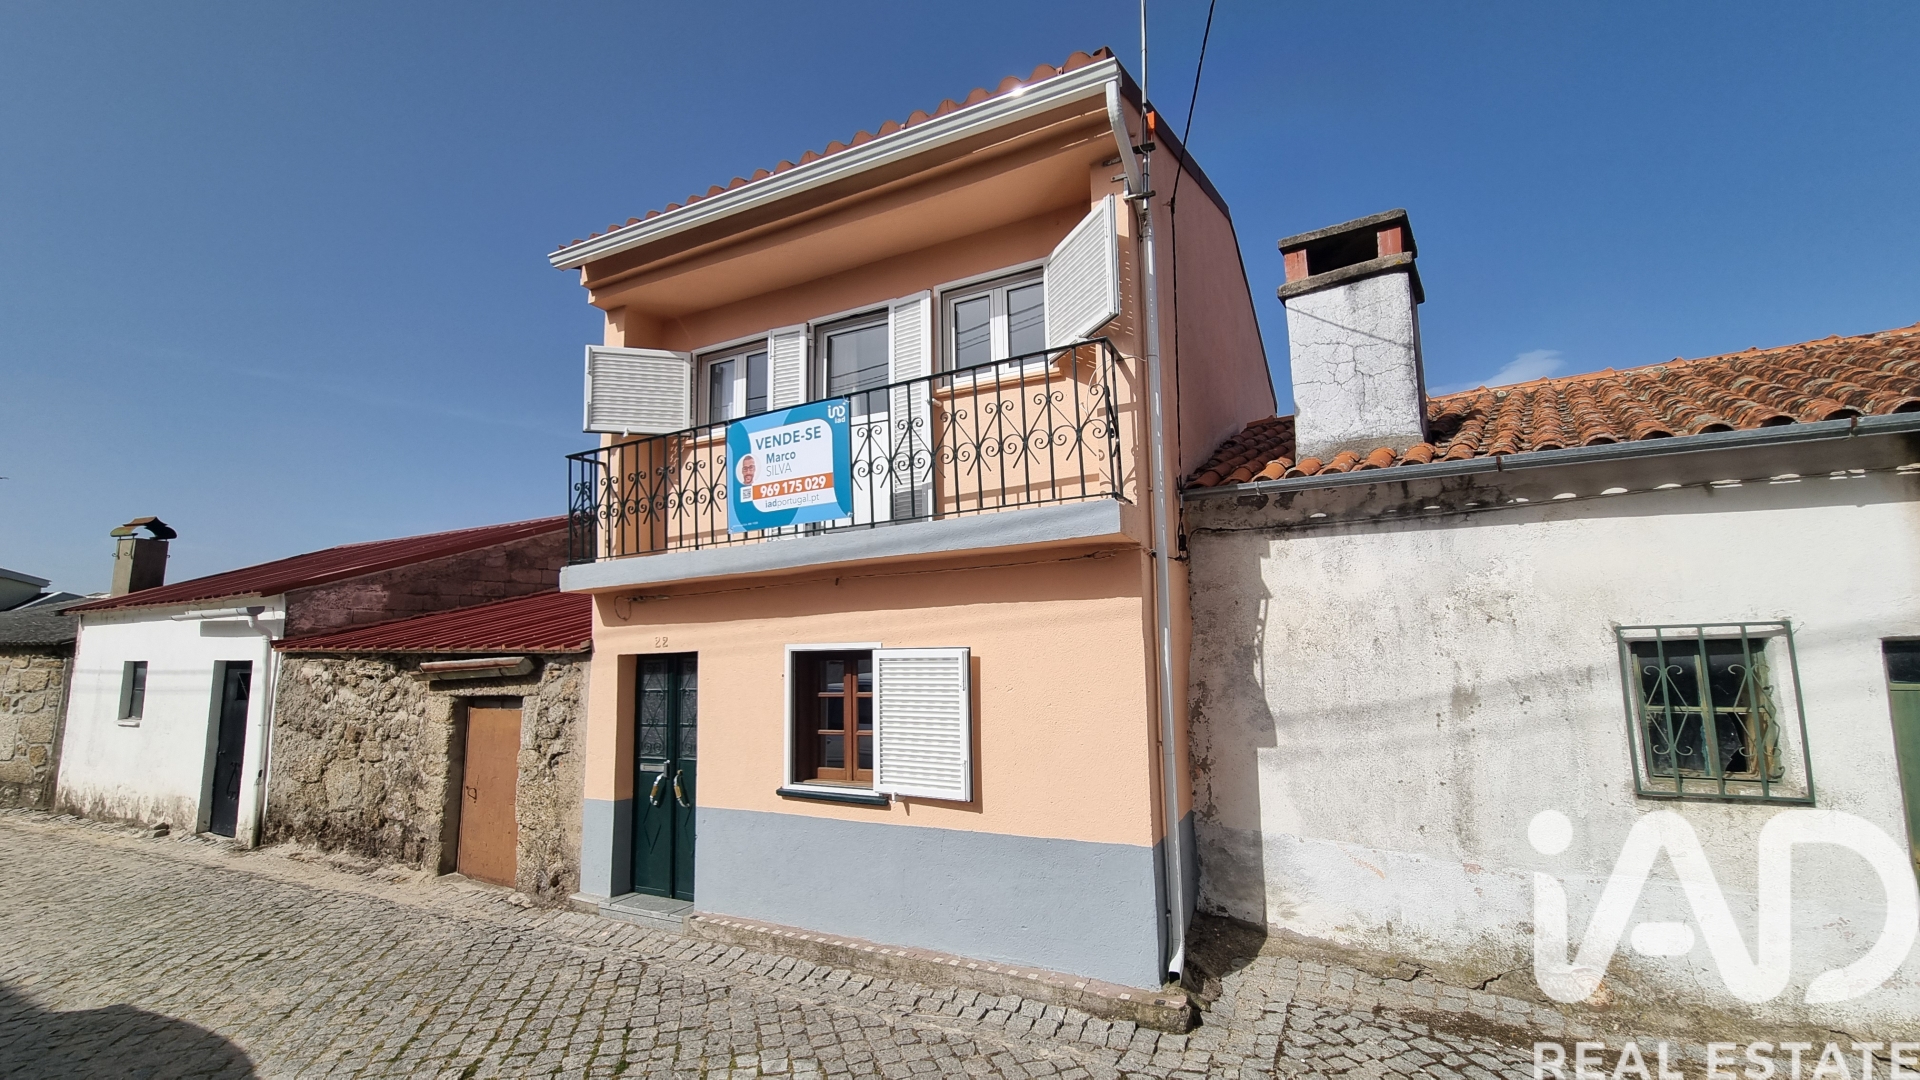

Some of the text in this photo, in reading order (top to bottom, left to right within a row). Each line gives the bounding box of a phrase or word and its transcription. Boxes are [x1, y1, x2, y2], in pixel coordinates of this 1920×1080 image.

[755, 425, 822, 451] VENDE-SE
[766, 451, 796, 464] Marco
[766, 463, 793, 477] SILVA
[760, 475, 827, 498] 969 175 029
[765, 493, 820, 509] iadportugal.pt
[654, 636, 669, 648] 22
